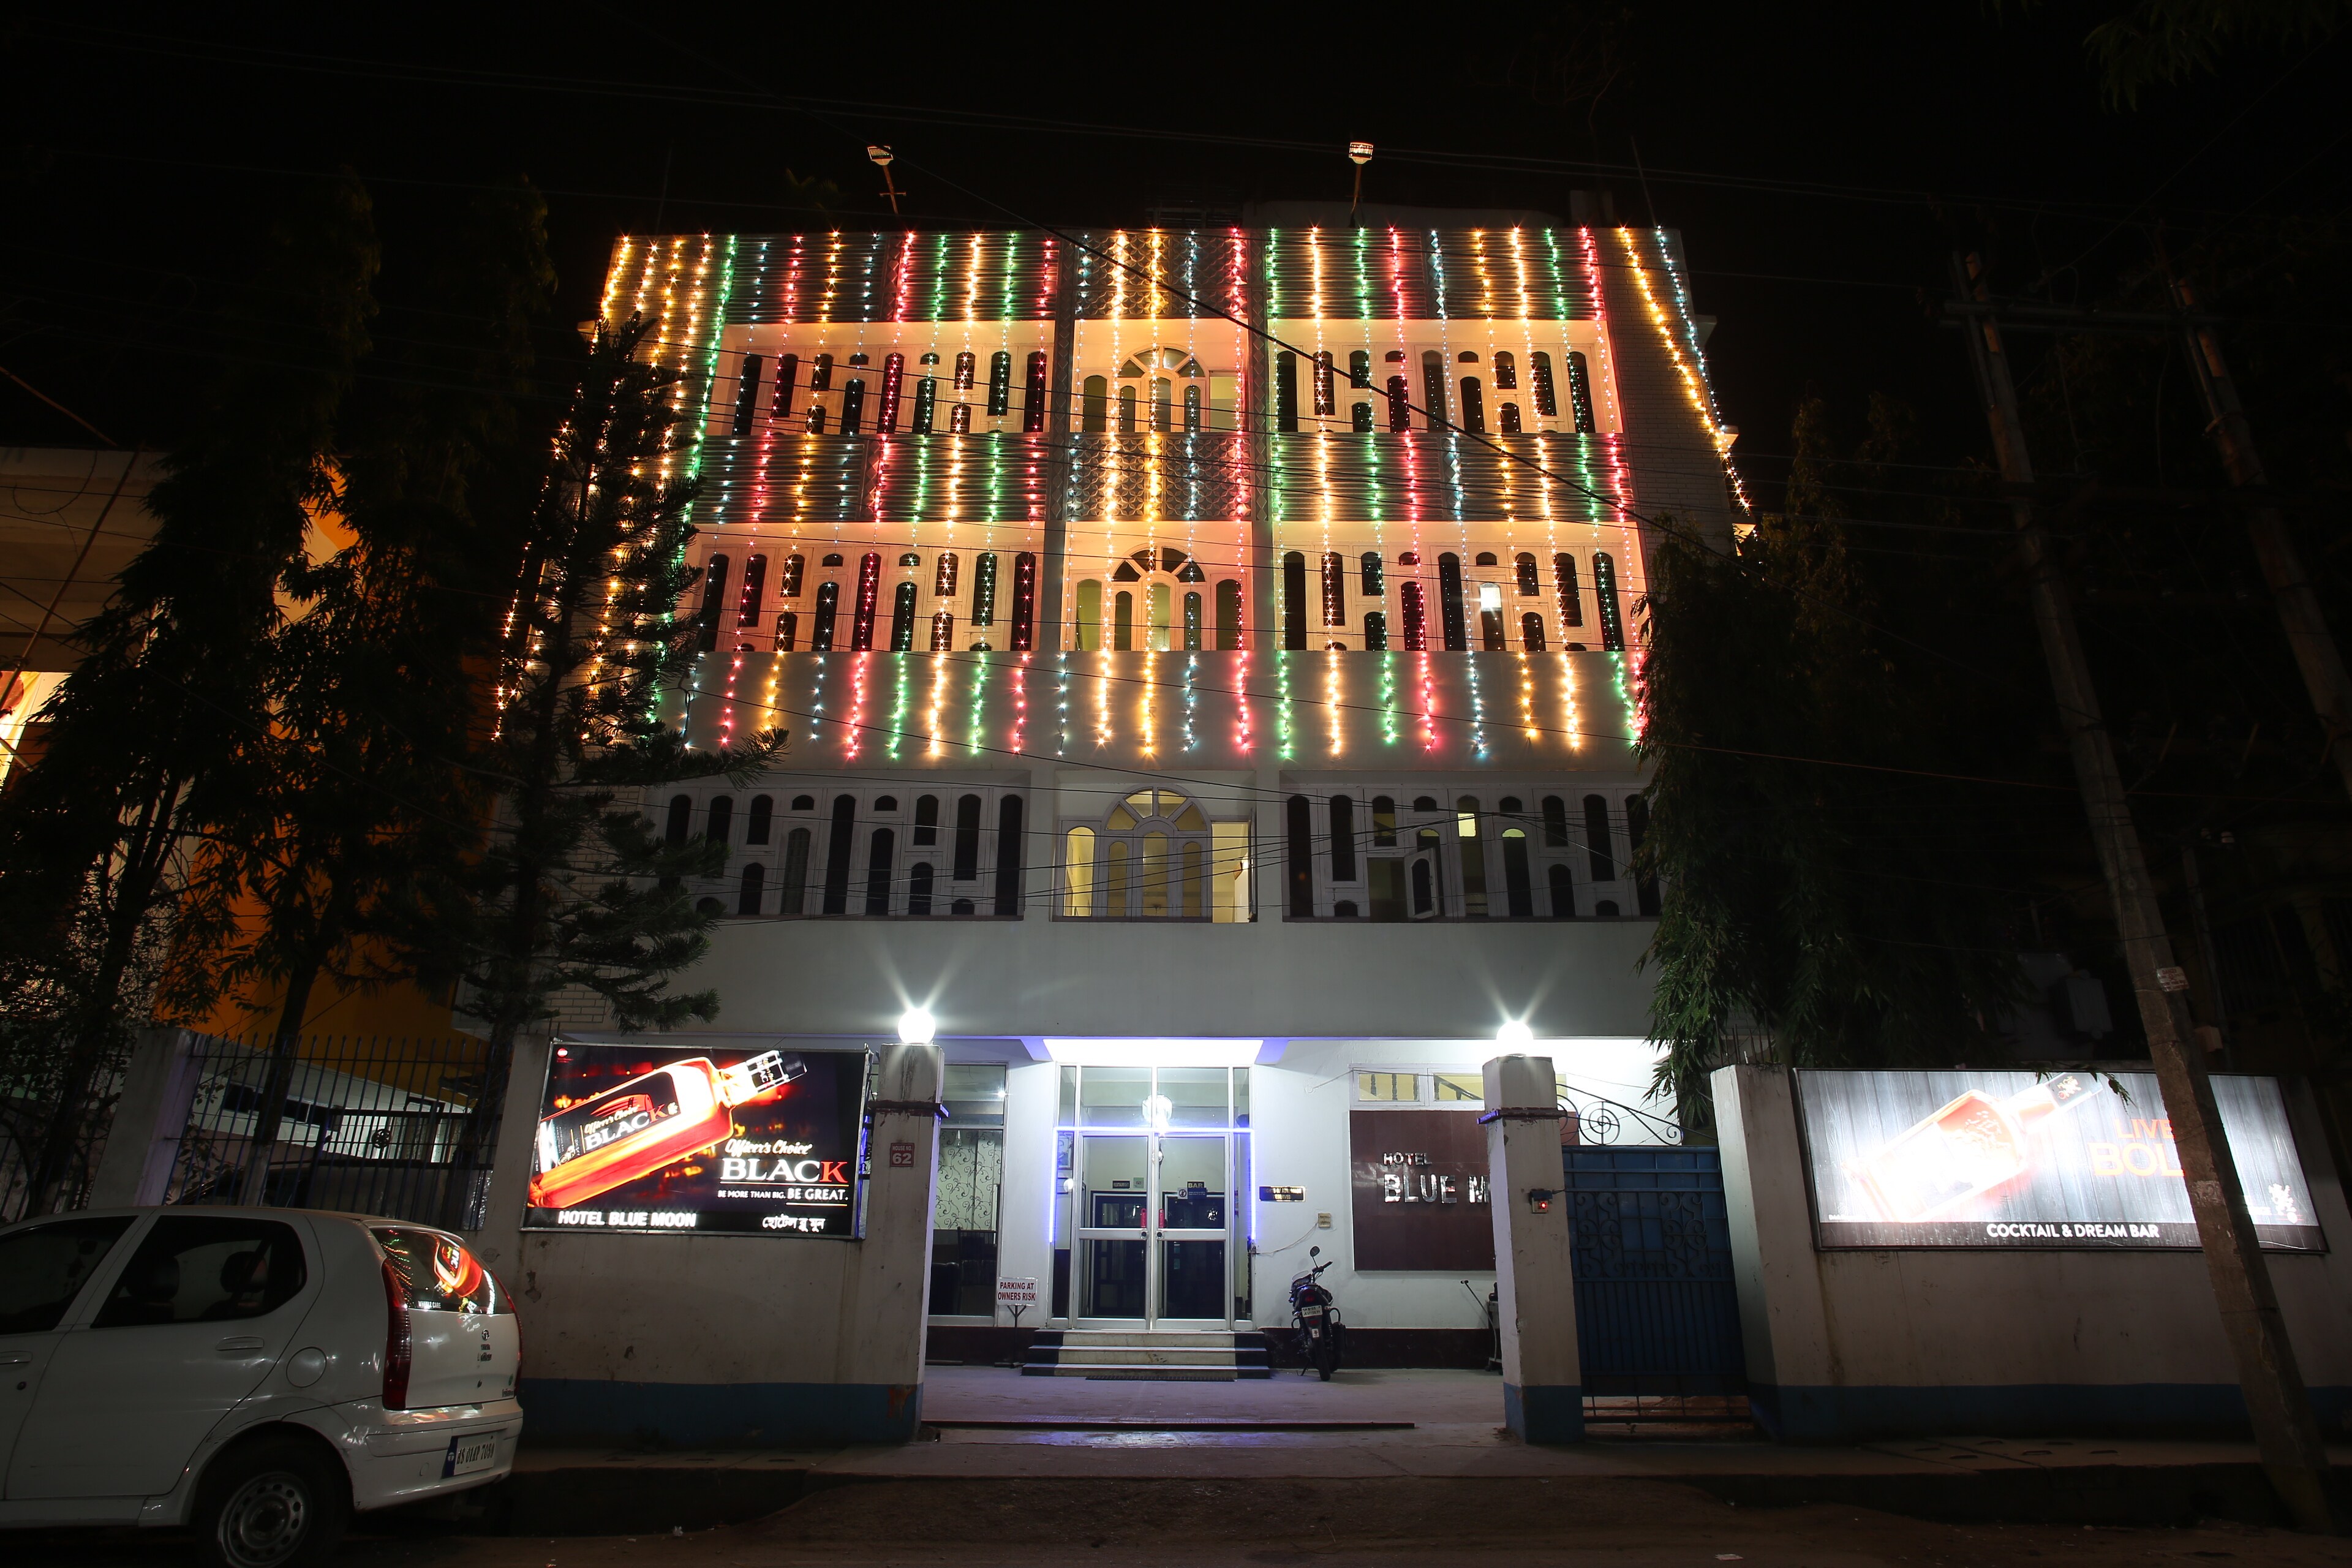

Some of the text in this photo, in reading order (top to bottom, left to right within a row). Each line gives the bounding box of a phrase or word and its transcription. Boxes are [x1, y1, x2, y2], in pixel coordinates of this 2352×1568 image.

[585, 1104, 669, 1150] BLACK
[2114, 1118, 2175, 1139] LIVE
[725, 1139, 813, 1157] Officer's Choice
[892, 1153, 911, 1164] 62
[1383, 1151, 1432, 1166] HOTEL
[720, 1158, 848, 1183] BLACK
[787, 1188, 801, 1199] BE
[805, 1189, 848, 1200] GREAT.
[1384, 1174, 1457, 1204] BLUE
[558, 1211, 696, 1227] HOTEL BLUE MOON
[1986, 1224, 2160, 1238] COCKTAIL & DREAM BAR
[998, 1292, 1035, 1301] OWNERS RISK
[456, 1447, 465, 1464] AS
